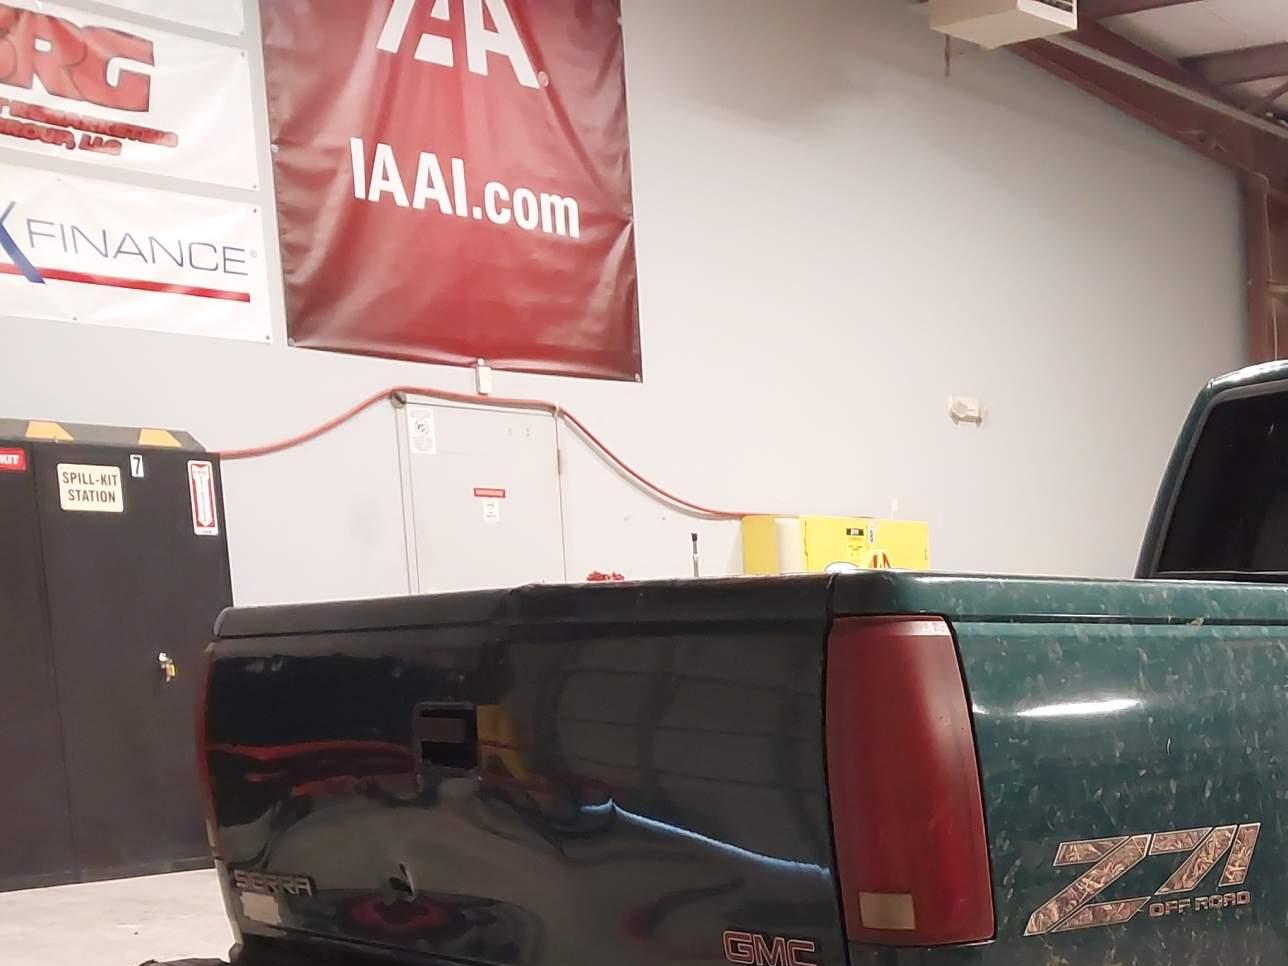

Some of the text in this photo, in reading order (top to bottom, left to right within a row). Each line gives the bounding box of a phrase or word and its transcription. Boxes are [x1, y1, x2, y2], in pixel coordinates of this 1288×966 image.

[350, 136, 580, 239] IAAI.com
[26, 218, 249, 276] FINANCE
[62, 471, 118, 487] SPILL-KIT
[132, 456, 141, 475] 7
[68, 489, 116, 503] STATION
[1024, 822, 1261, 936] Z71
[1149, 888, 1250, 917] OFF ROAD
